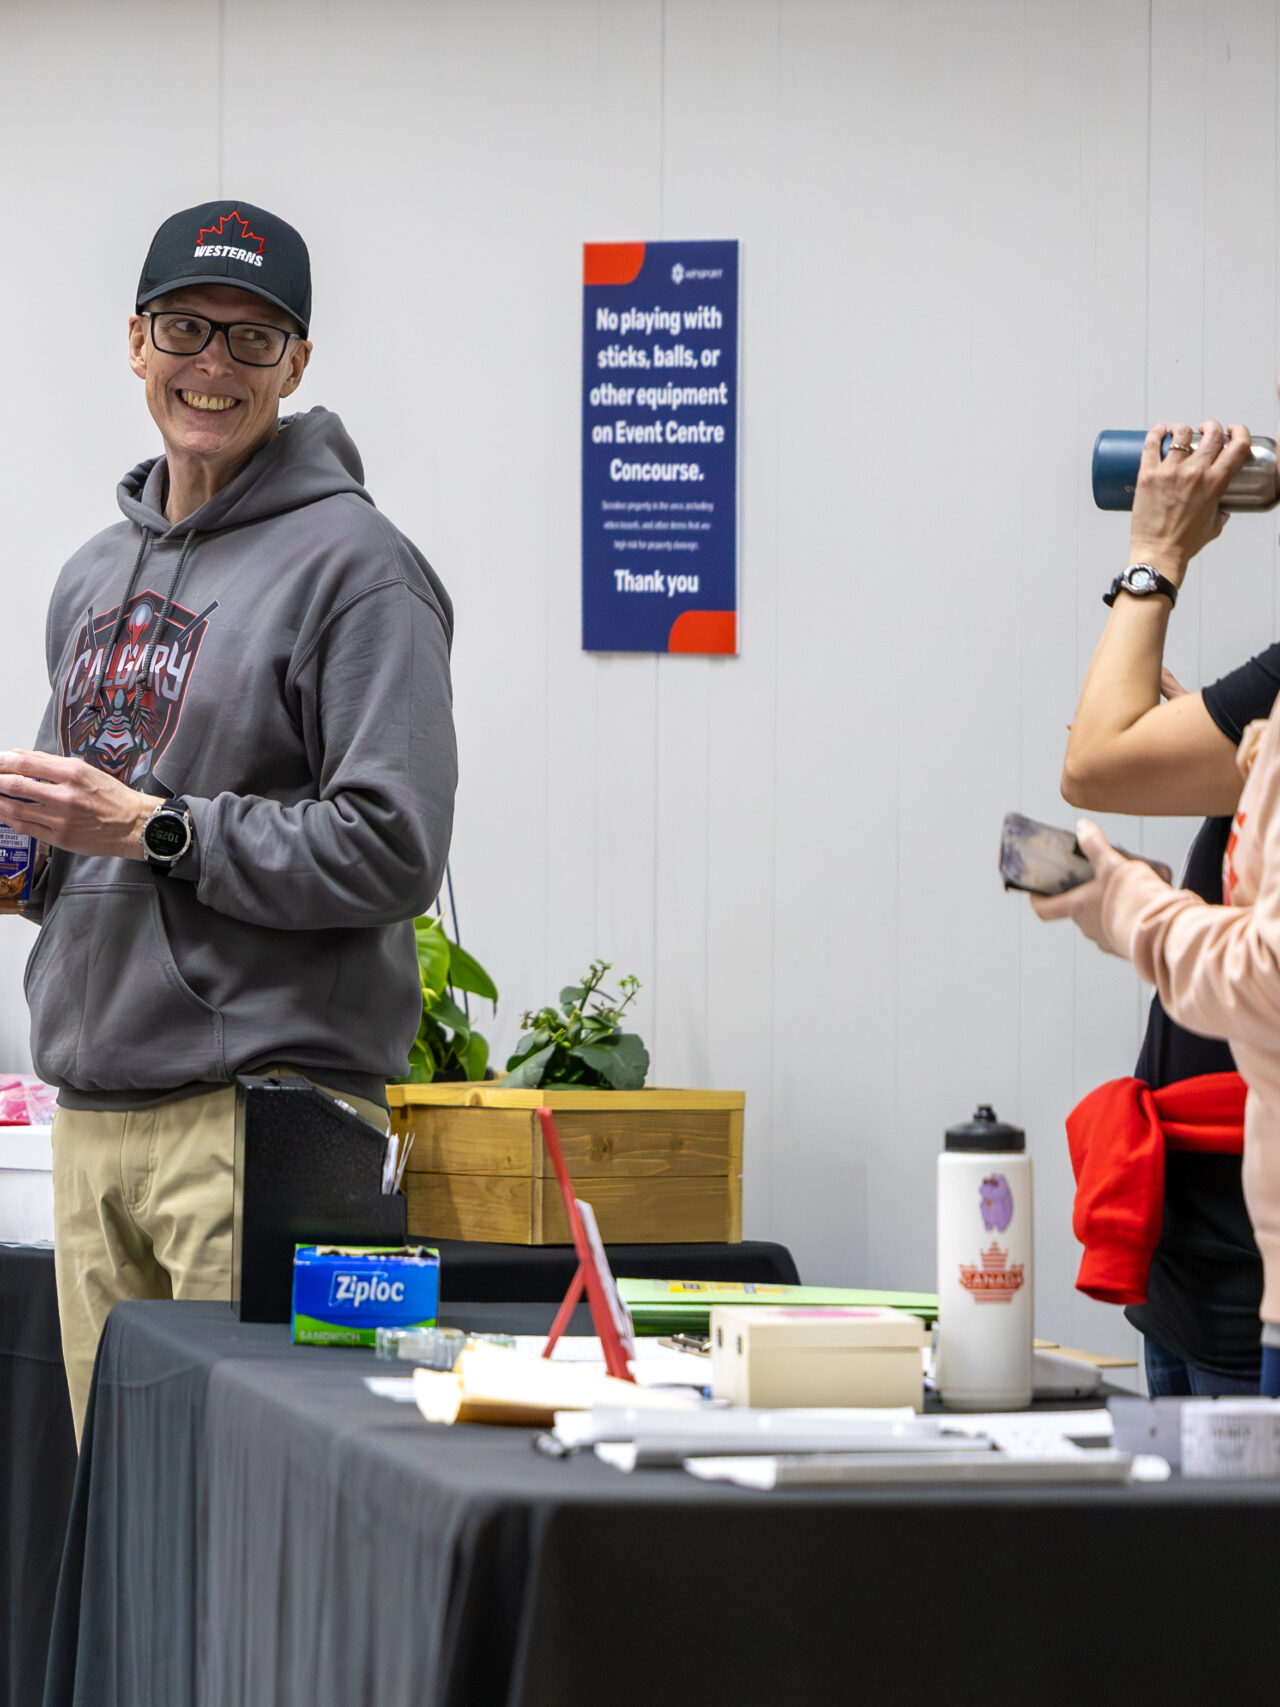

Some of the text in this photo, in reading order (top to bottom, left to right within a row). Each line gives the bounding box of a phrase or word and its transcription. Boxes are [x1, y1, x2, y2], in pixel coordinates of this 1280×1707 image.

[194, 245, 263, 267] WESTERNS
[596, 306, 722, 335] No playing with
[597, 344, 721, 369] sticks, balls, or
[590, 381, 728, 411] other equipment
[592, 420, 725, 444] on Event Centre
[610, 458, 704, 482] Concourse.
[614, 569, 699, 597] Thank you
[66, 641, 192, 706] CALGARY
[336, 1275, 405, 1308] Ziploc
[299, 1330, 361, 1343] SANDWICH
